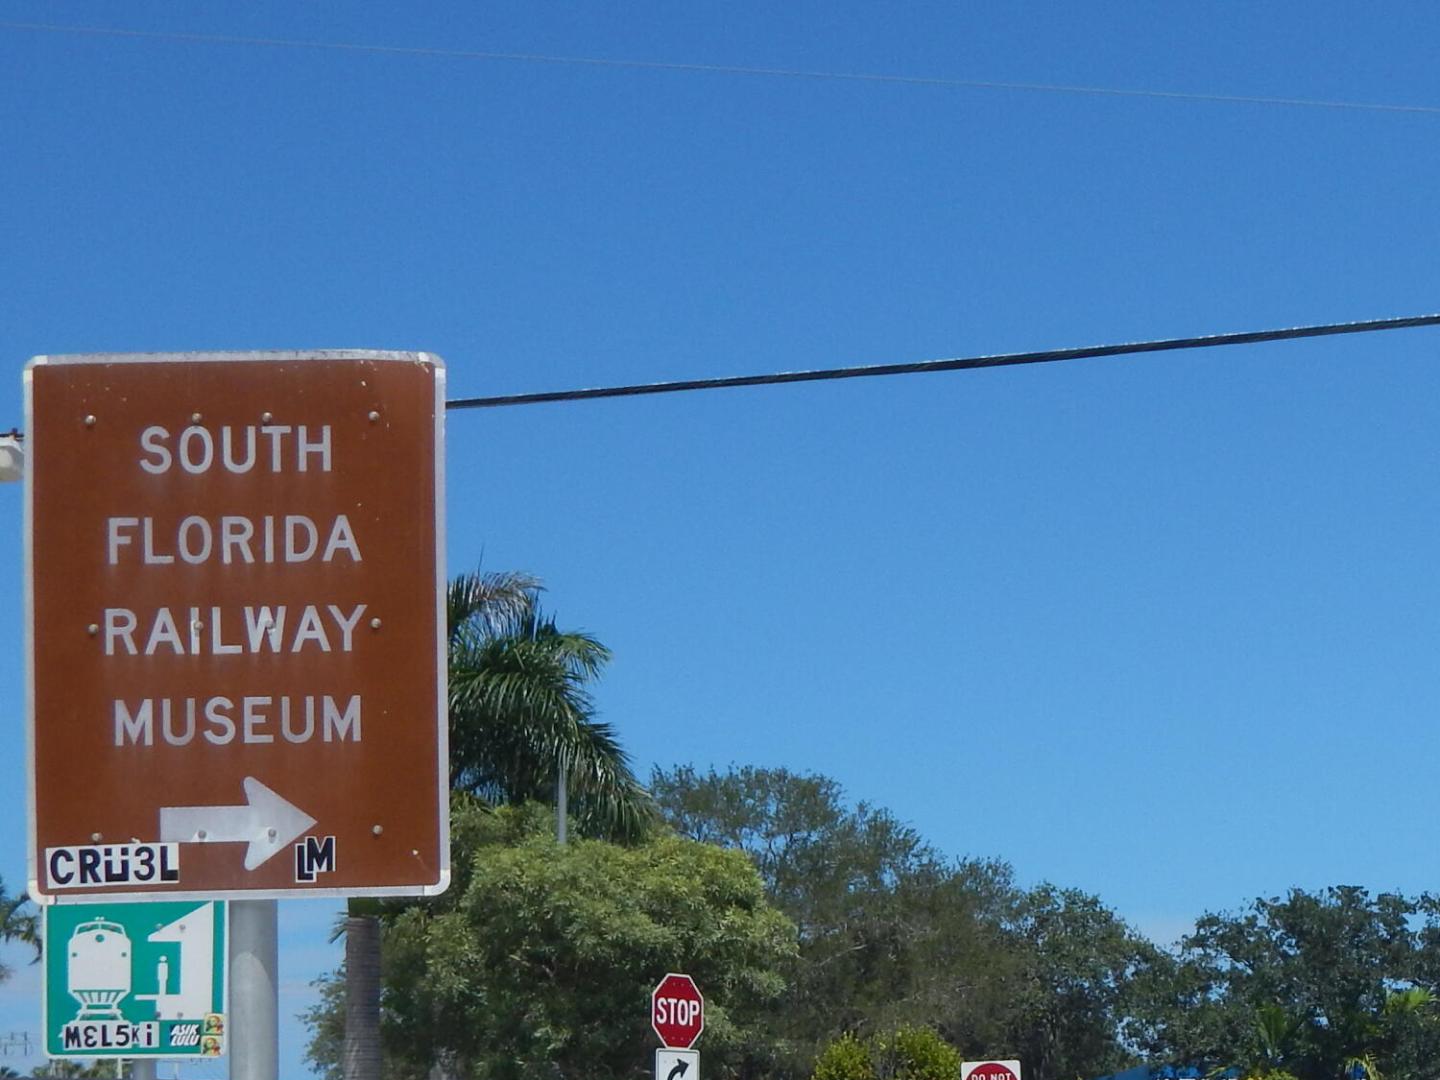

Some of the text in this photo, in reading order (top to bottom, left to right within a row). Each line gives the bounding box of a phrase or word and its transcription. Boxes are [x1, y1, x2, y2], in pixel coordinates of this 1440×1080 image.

[140, 425, 332, 474] SOUTH
[108, 515, 362, 565] FLORIDA
[104, 604, 367, 655] RAILWAY
[115, 695, 362, 746] MUSEUM
[656, 997, 700, 1026] STOP
